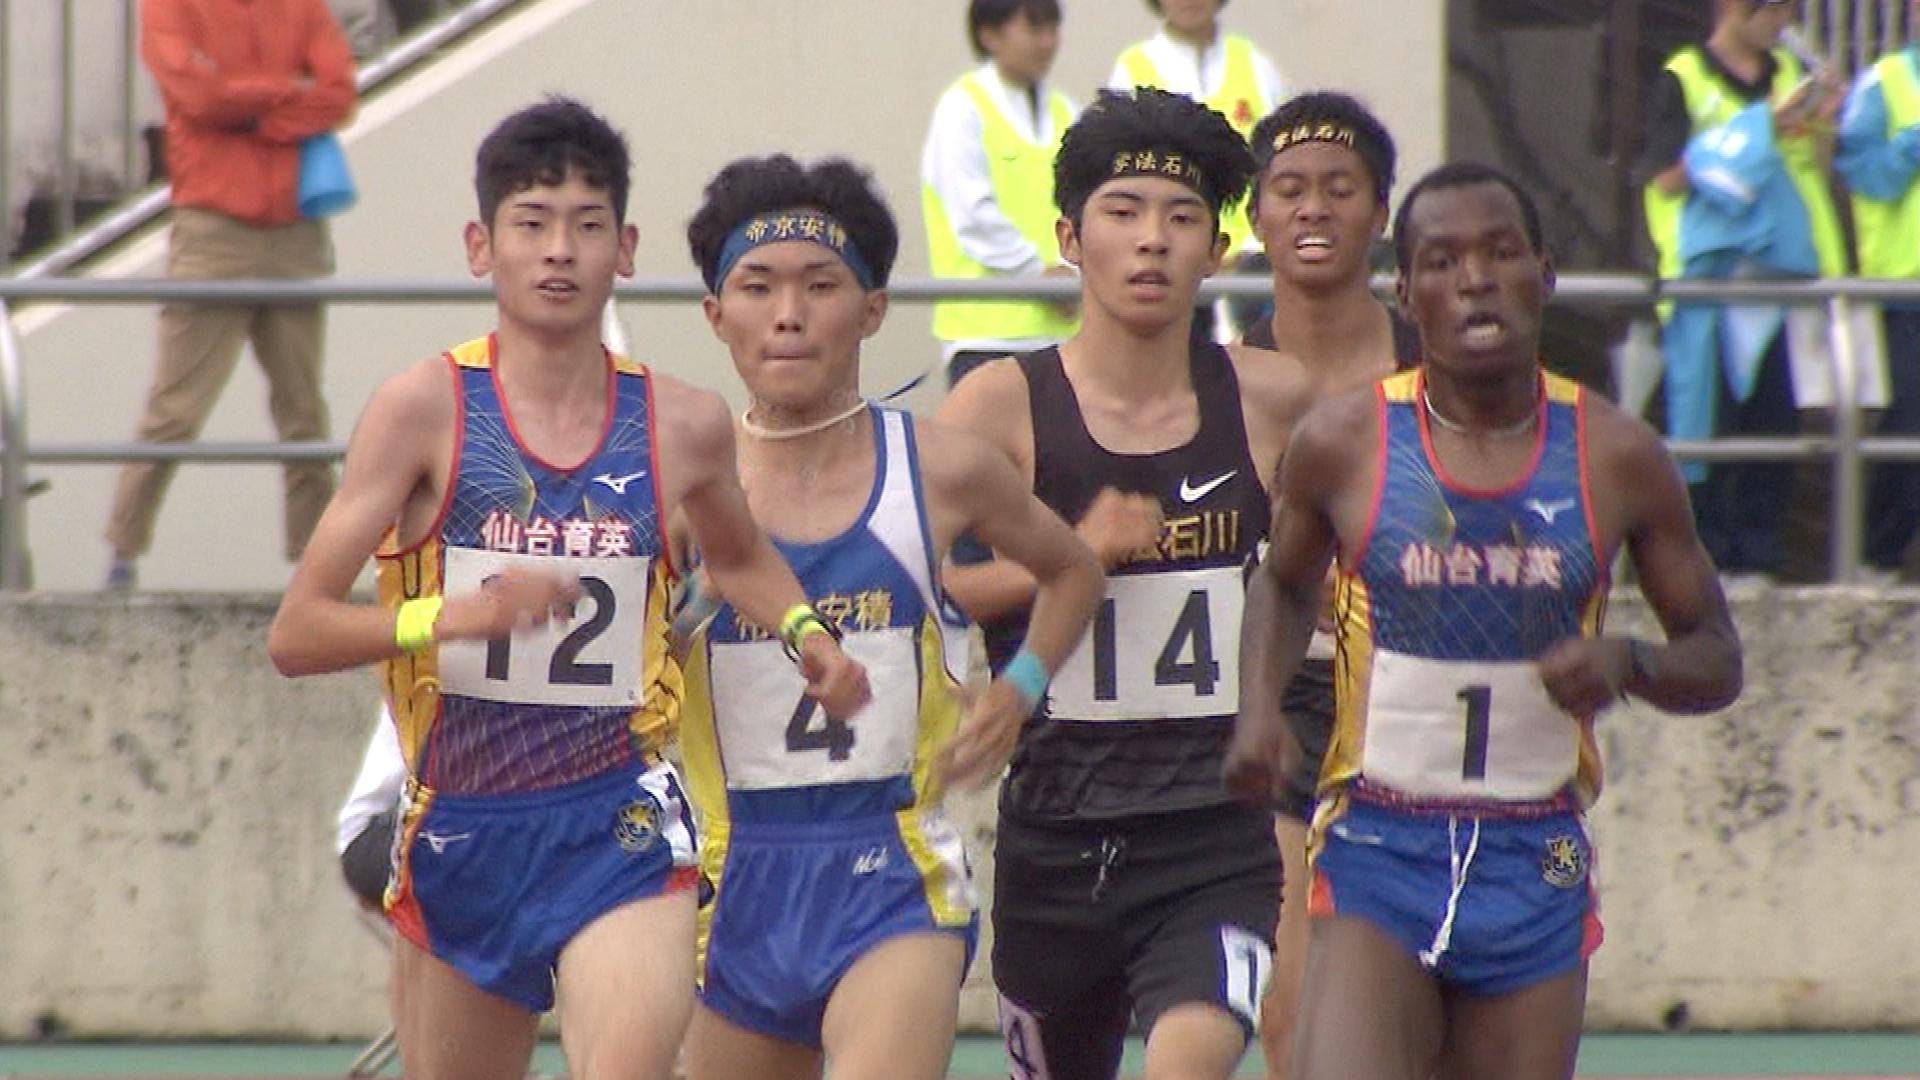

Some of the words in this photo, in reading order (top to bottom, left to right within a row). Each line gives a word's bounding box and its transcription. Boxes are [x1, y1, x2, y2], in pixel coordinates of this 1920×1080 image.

[481, 511, 632, 558] 仙台育英
[1401, 543, 1562, 589] 仙台育英
[1093, 590, 1220, 701] 14
[786, 682, 855, 761] 4
[1456, 685, 1492, 781] 1
